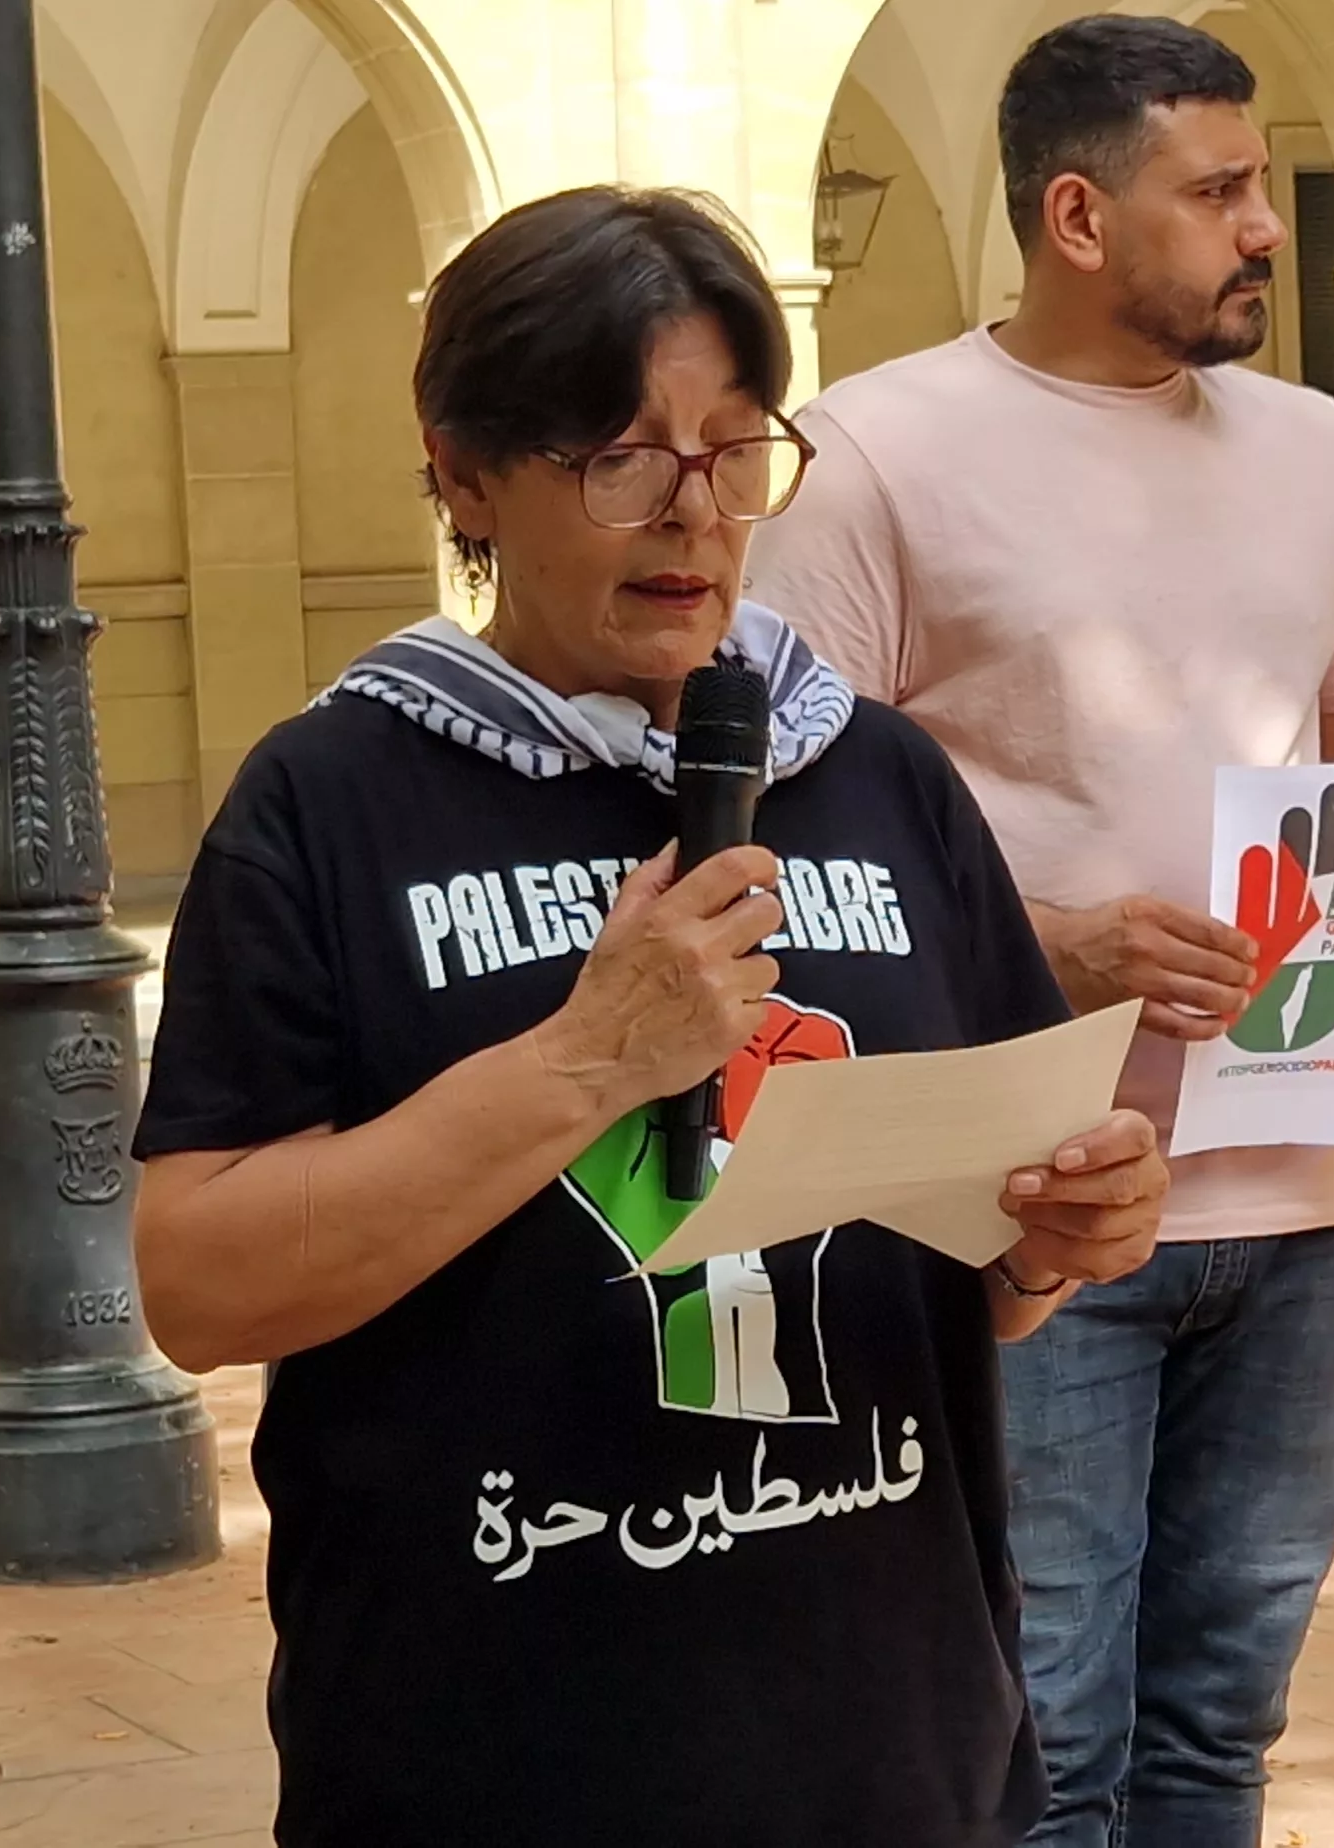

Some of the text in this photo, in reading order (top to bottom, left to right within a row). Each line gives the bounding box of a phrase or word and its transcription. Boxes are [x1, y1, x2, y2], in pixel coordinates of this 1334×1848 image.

[407, 857, 639, 990] PALEST
[473, 1405, 924, 1583] فلسطين حرة
